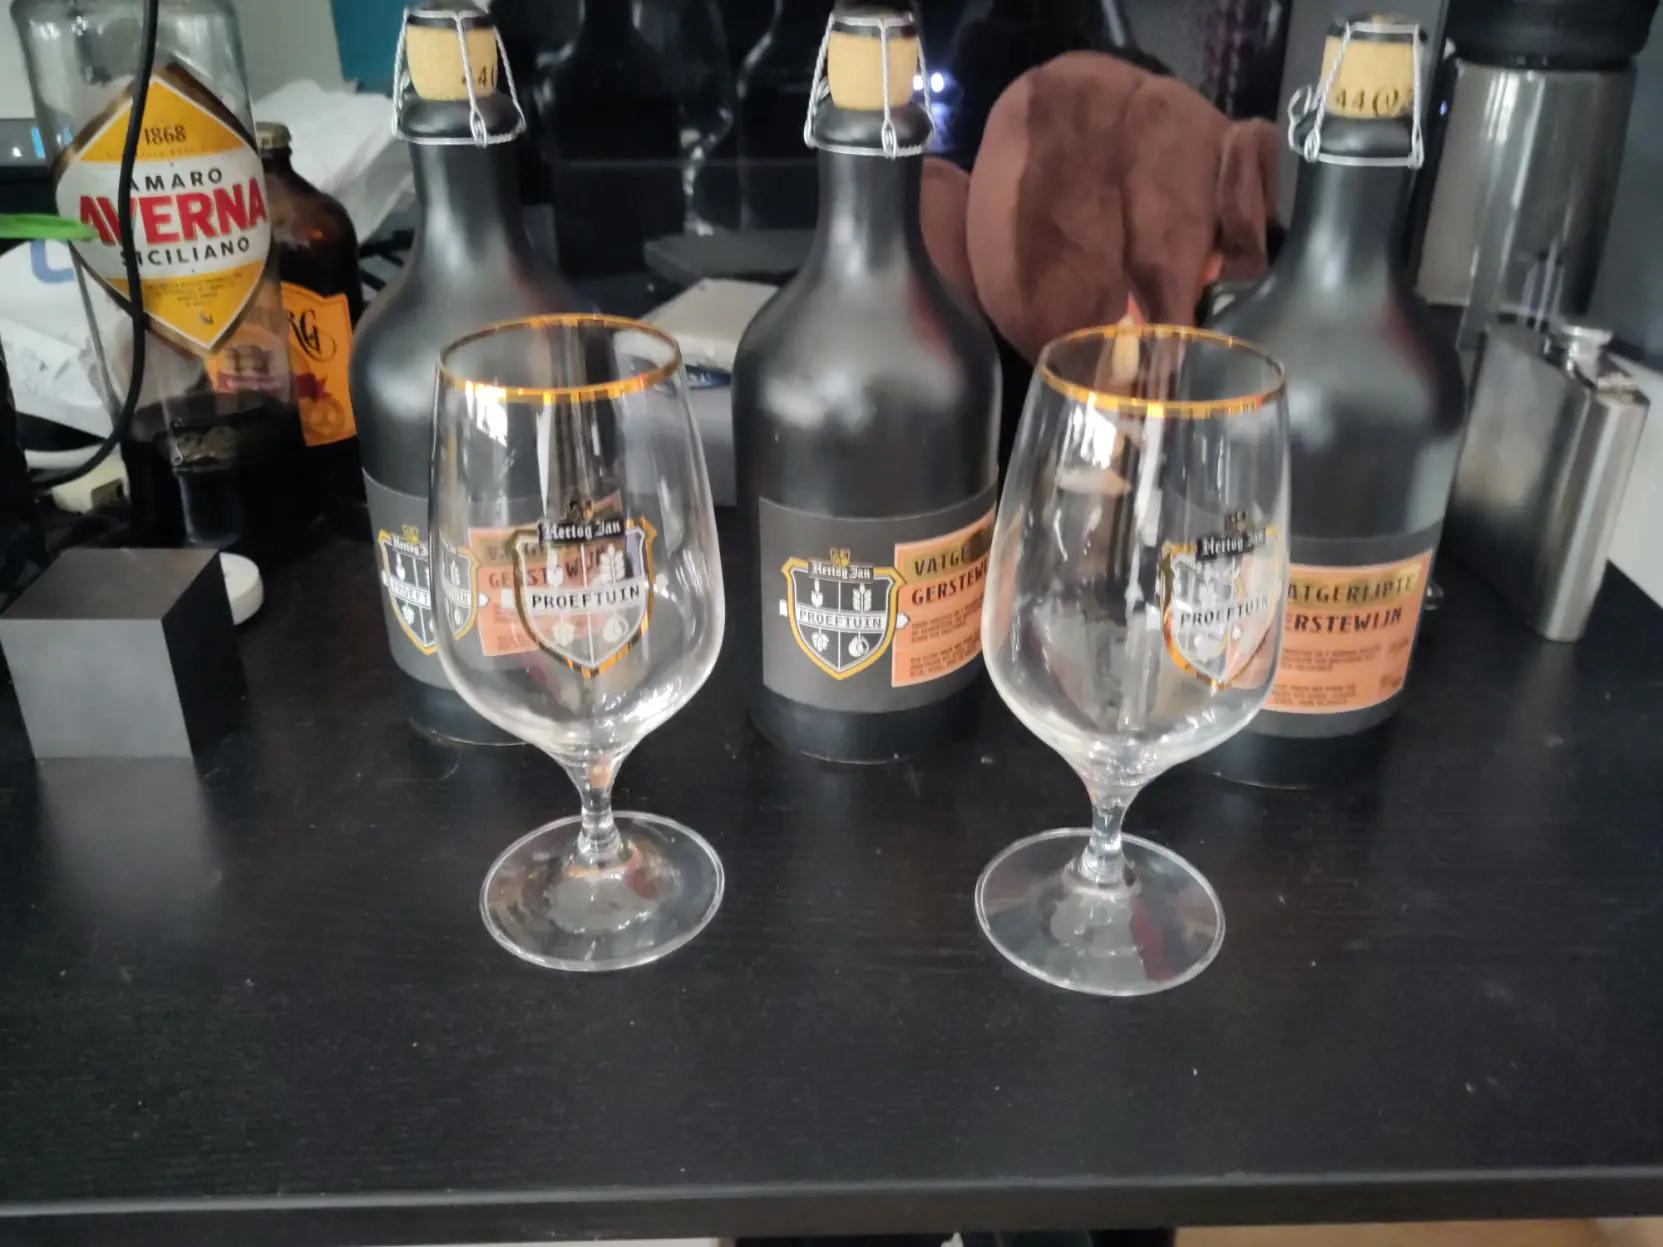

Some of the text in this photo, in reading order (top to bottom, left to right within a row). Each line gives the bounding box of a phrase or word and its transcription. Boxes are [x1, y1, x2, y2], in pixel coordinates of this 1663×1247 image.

[144, 125, 188, 146] 1868
[79, 176, 268, 247] AVERNA
[545, 519, 622, 541] Hertog Jan
[811, 559, 871, 581] Hertog Jan
[531, 585, 641, 610] PROEFTUIN
[800, 608, 882, 630] PROEFTUIN
[1284, 606, 1402, 633] ERSTEWIJN
